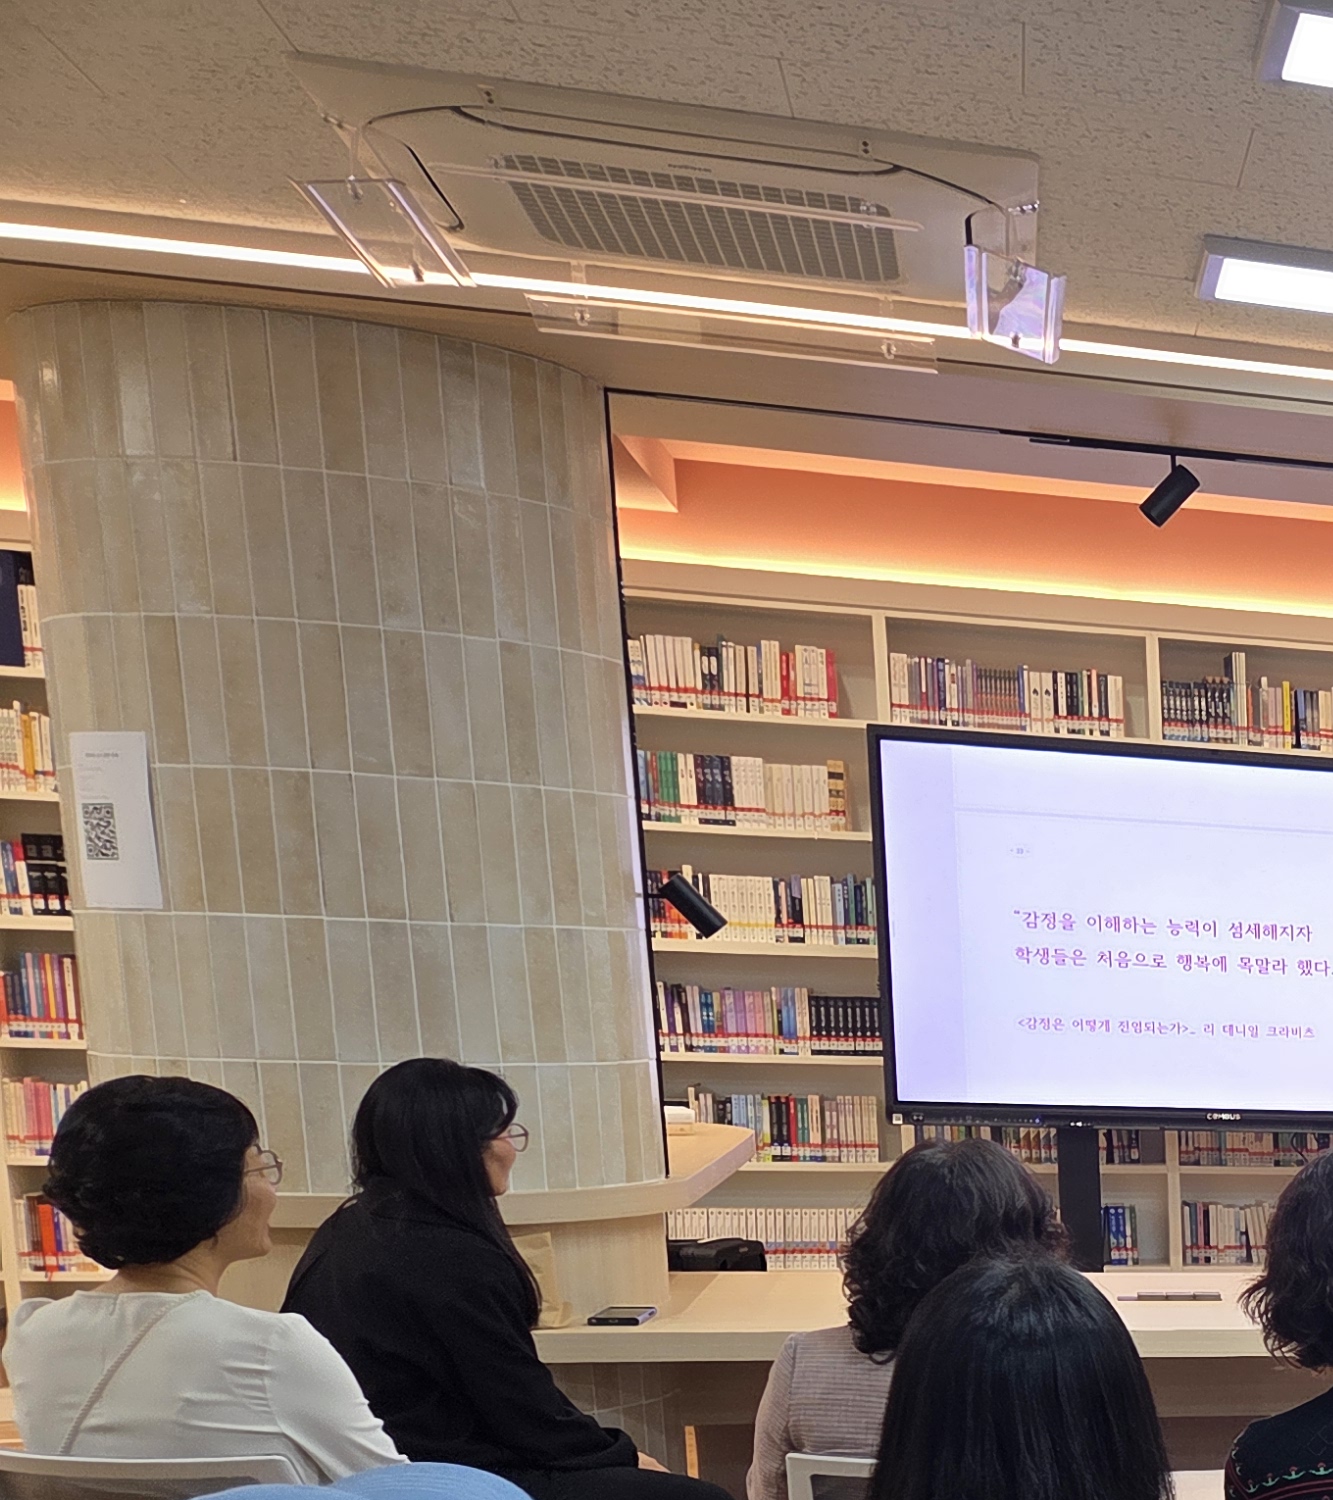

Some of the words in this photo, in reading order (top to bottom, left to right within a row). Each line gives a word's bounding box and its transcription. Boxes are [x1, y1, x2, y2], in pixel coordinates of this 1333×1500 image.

[1087, 914, 1157, 935] 이해하는
[1166, 918, 1217, 938] 능력이
[1228, 921, 1313, 943] 섬세해지자
[1015, 946, 1087, 966] 학생들은
[1097, 950, 1168, 969] 처음으로
[1237, 956, 1288, 976] 목말라
[1203, 1023, 1215, 1036] 리
